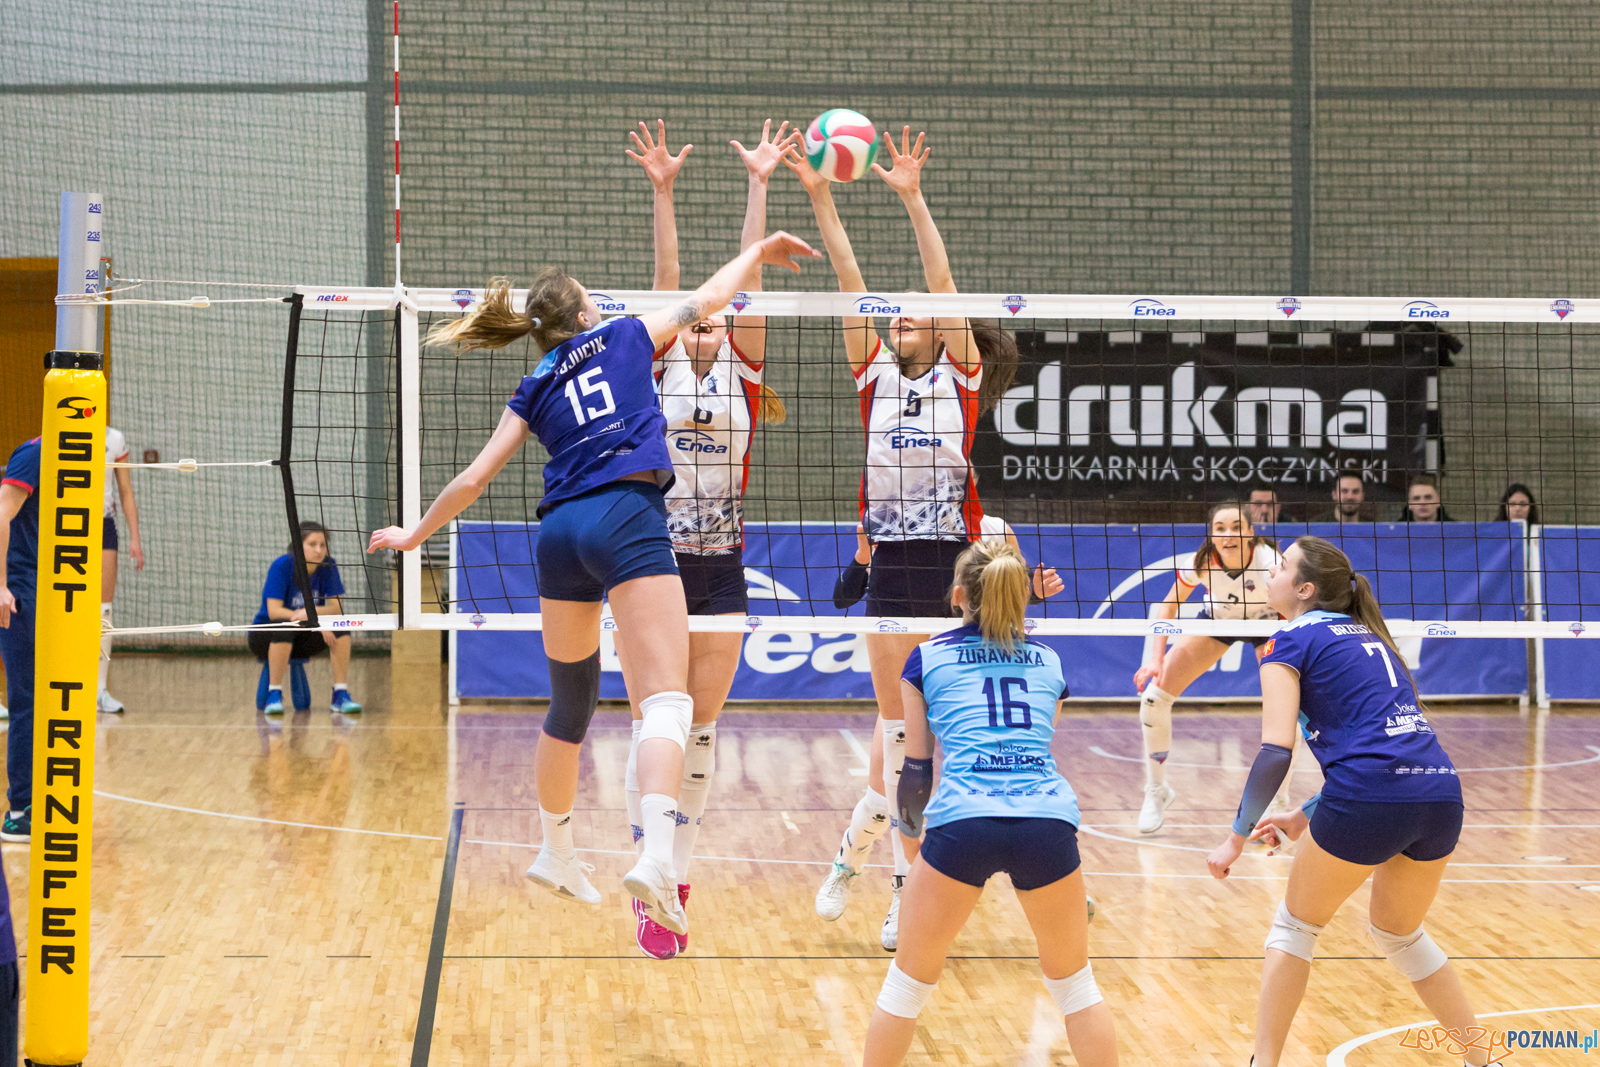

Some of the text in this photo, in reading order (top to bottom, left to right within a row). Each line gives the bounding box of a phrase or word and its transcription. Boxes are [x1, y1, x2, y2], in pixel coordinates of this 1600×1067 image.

[88, 203, 101, 211] 243
[87, 231, 100, 239] 235
[316, 294, 349, 302] netex
[596, 303, 626, 311] nea
[859, 303, 901, 314] Enea
[1134, 305, 1176, 316] Enea
[1408, 307, 1450, 318] Enea
[564, 366, 616, 426] 15
[903, 389, 922, 417] 5
[994, 360, 1388, 449] drukma
[676, 437, 728, 454] Enea
[891, 435, 942, 449] Enea
[1002, 451, 1388, 483] DRUKARNIA SKOCZYŃSKI
[53, 431, 93, 613] SPORT
[332, 620, 364, 628] netex
[1153, 626, 1183, 634] Enea
[1428, 628, 1457, 636] Enea
[956, 646, 1045, 667] ŻURAWSKA
[1361, 641, 1399, 688] 7
[981, 676, 1033, 730] 16
[990, 754, 1046, 767] MEKRO
[41, 681, 84, 975] TRANSFER
